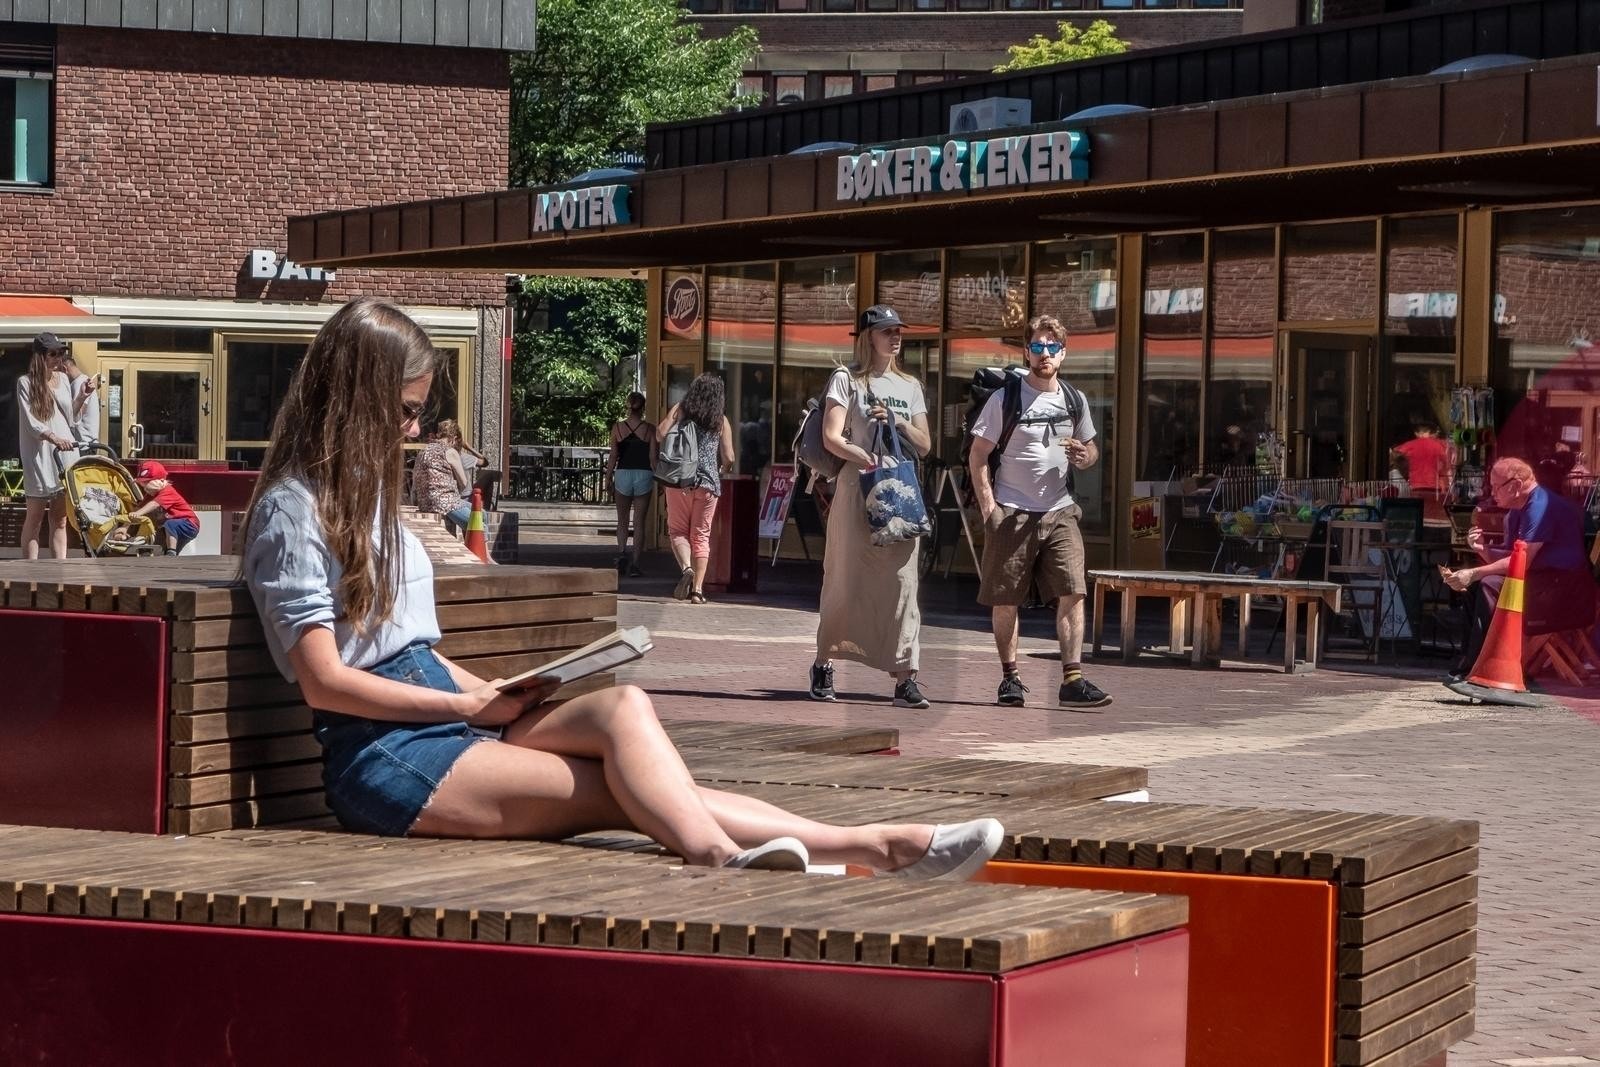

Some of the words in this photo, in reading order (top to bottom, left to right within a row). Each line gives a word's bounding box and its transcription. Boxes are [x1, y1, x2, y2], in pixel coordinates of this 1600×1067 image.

[837, 146, 932, 200] BØKER
[939, 140, 965, 191] &
[970, 131, 1074, 189] LEKER
[533, 185, 618, 232] APOTEK
